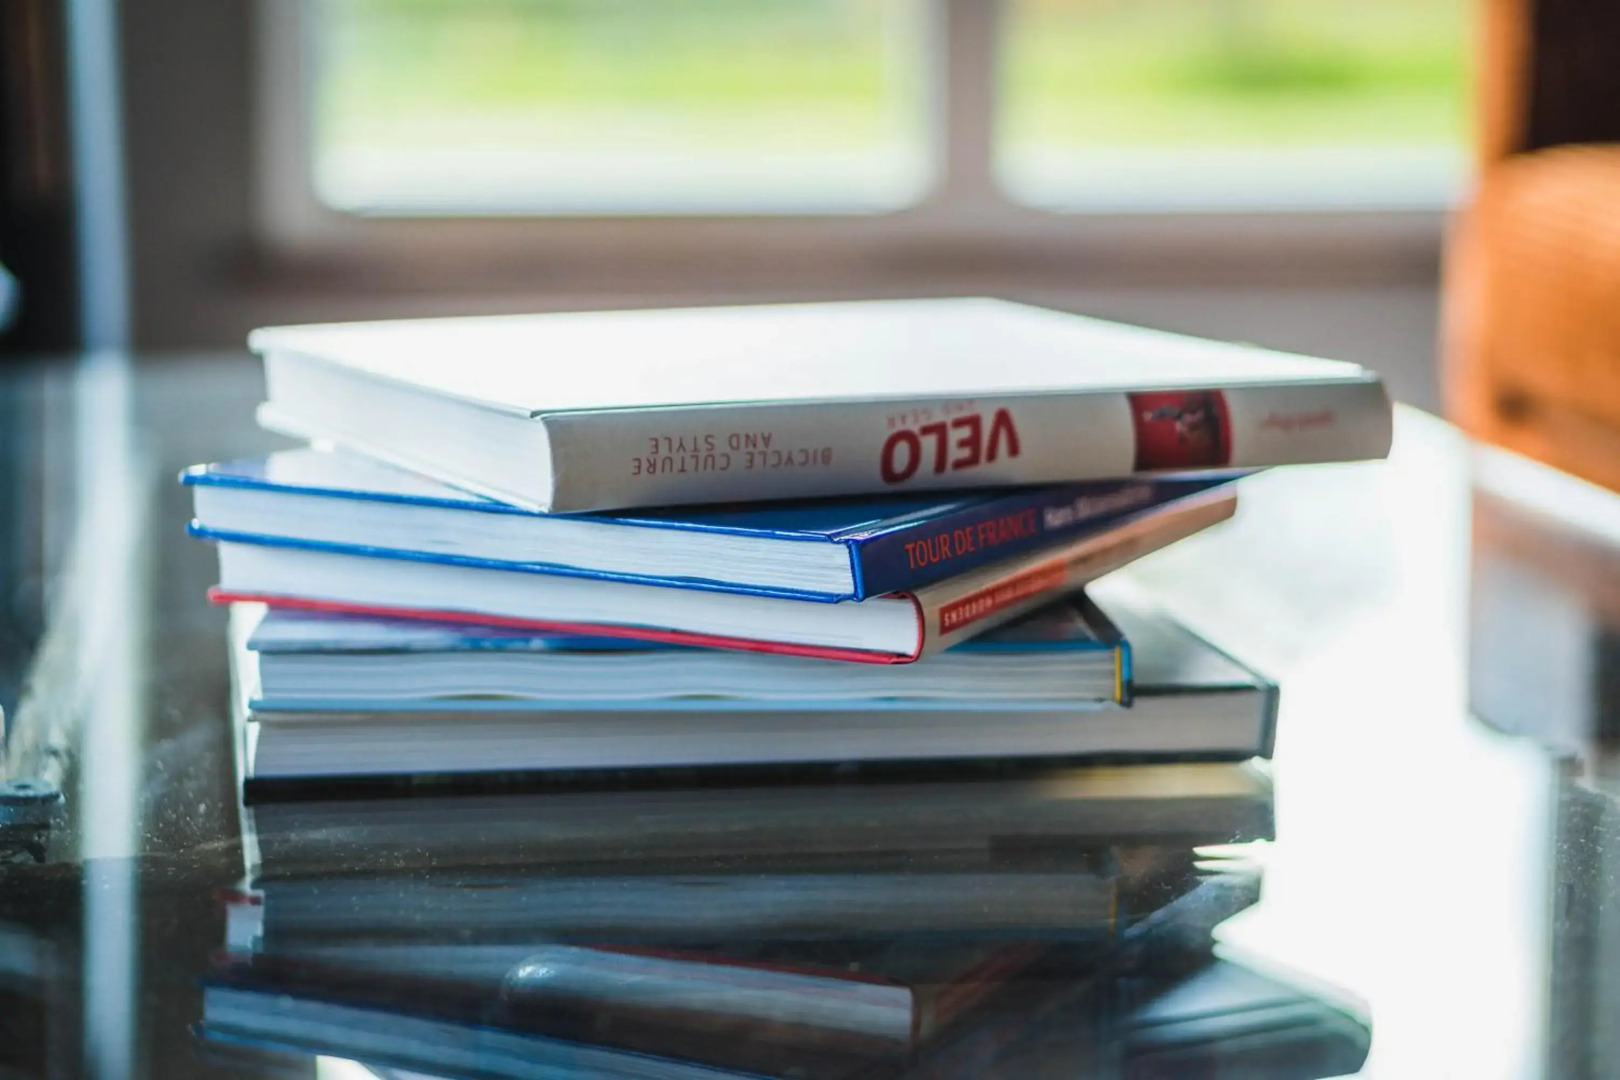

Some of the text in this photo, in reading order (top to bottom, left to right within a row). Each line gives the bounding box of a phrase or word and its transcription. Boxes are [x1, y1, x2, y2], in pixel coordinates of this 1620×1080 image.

[631, 446, 833, 476] BICYCLE CULTURE
[649, 432, 773, 454] AND STYLE
[880, 407, 1021, 485] VELO
[904, 511, 1036, 570] TOUR DE FRANCE
